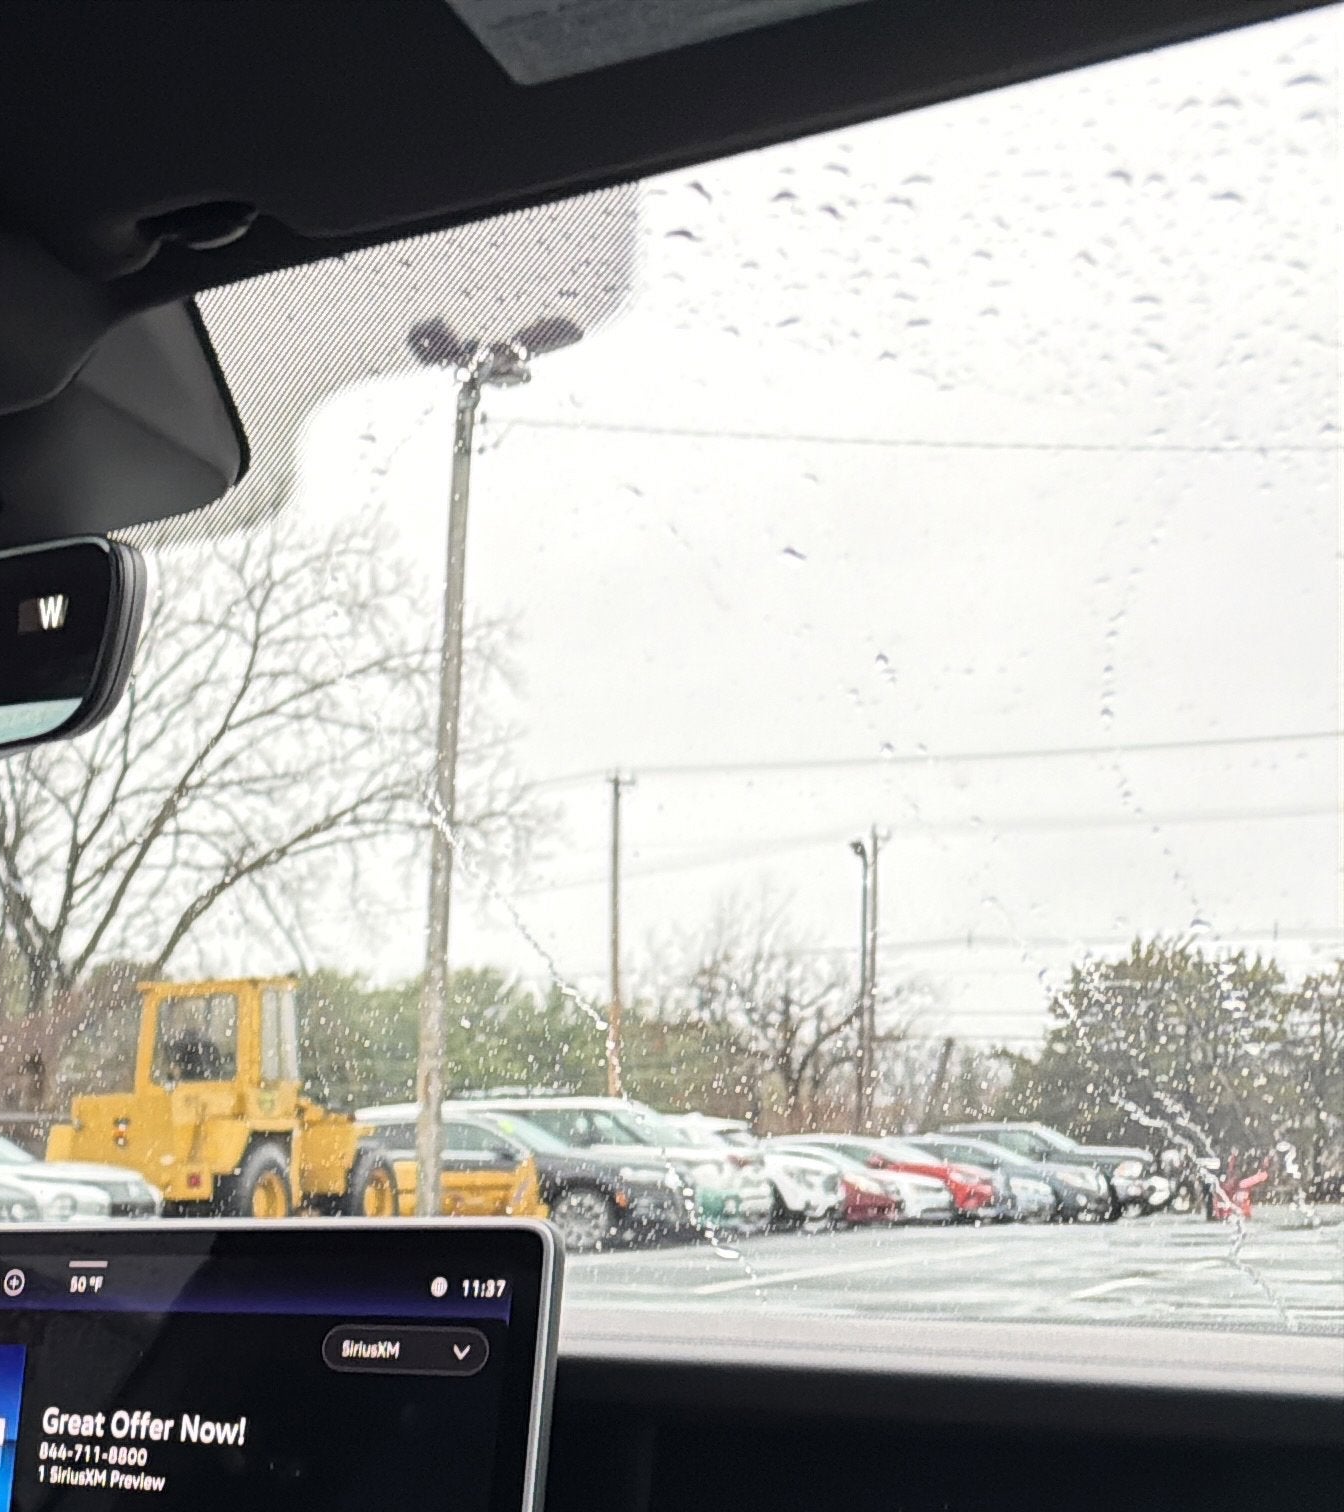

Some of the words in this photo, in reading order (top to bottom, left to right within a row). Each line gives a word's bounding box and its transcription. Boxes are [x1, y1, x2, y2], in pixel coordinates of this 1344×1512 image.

[38, 594, 64, 631] W
[462, 1279, 506, 1298] 11:37
[341, 1339, 401, 1360] SiriusXM
[42, 1406, 106, 1438] Great
[110, 1410, 175, 1441] Offer
[179, 1414, 247, 1446] Now!
[38, 1442, 148, 1467] 844-711-8800
[38, 1465, 45, 1483] 1
[49, 1465, 107, 1488] SiriusXM
[110, 1469, 166, 1492] Preview
